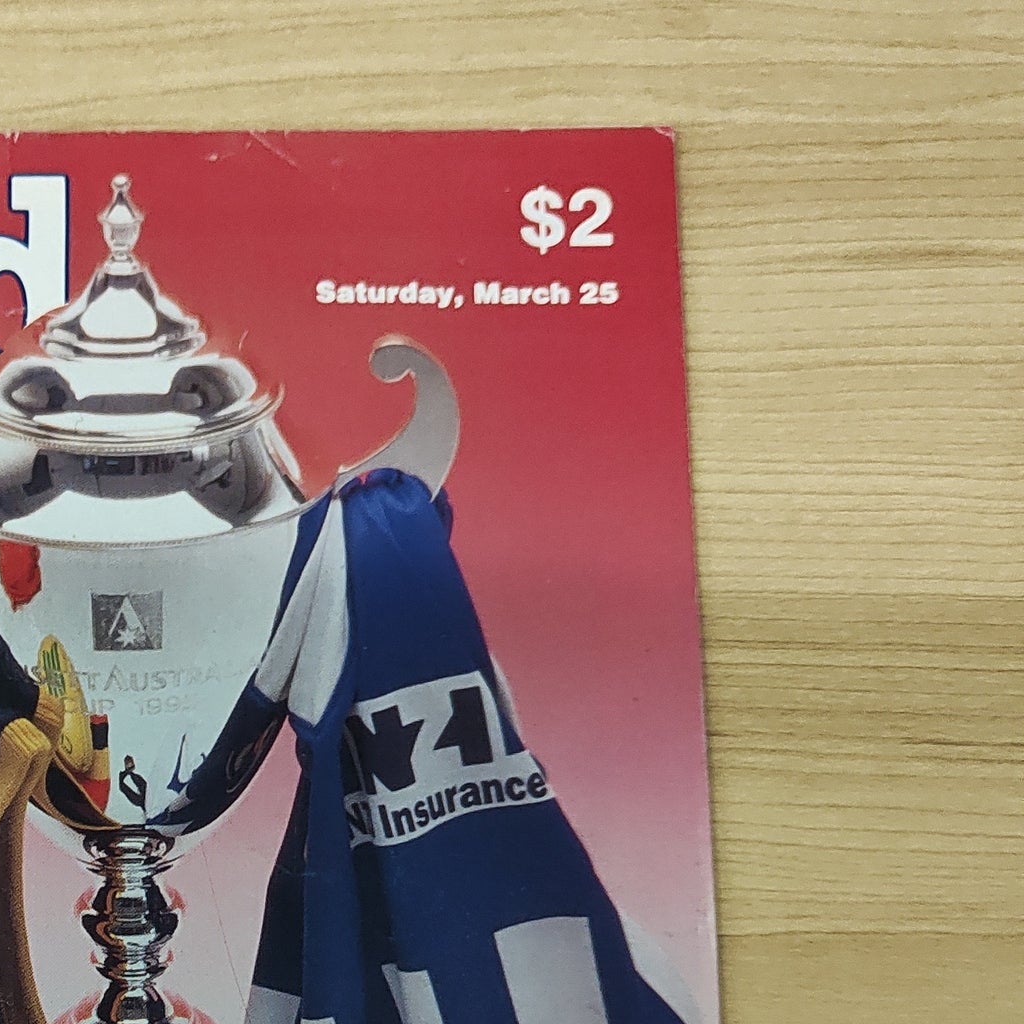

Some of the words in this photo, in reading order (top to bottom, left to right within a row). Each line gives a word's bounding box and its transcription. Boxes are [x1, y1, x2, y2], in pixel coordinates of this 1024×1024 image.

[519, 186, 615, 255] $2
[315, 279, 464, 310] Saturday,
[473, 281, 570, 305] March
[578, 282, 619, 305] 25
[378, 771, 548, 838] Insurance
